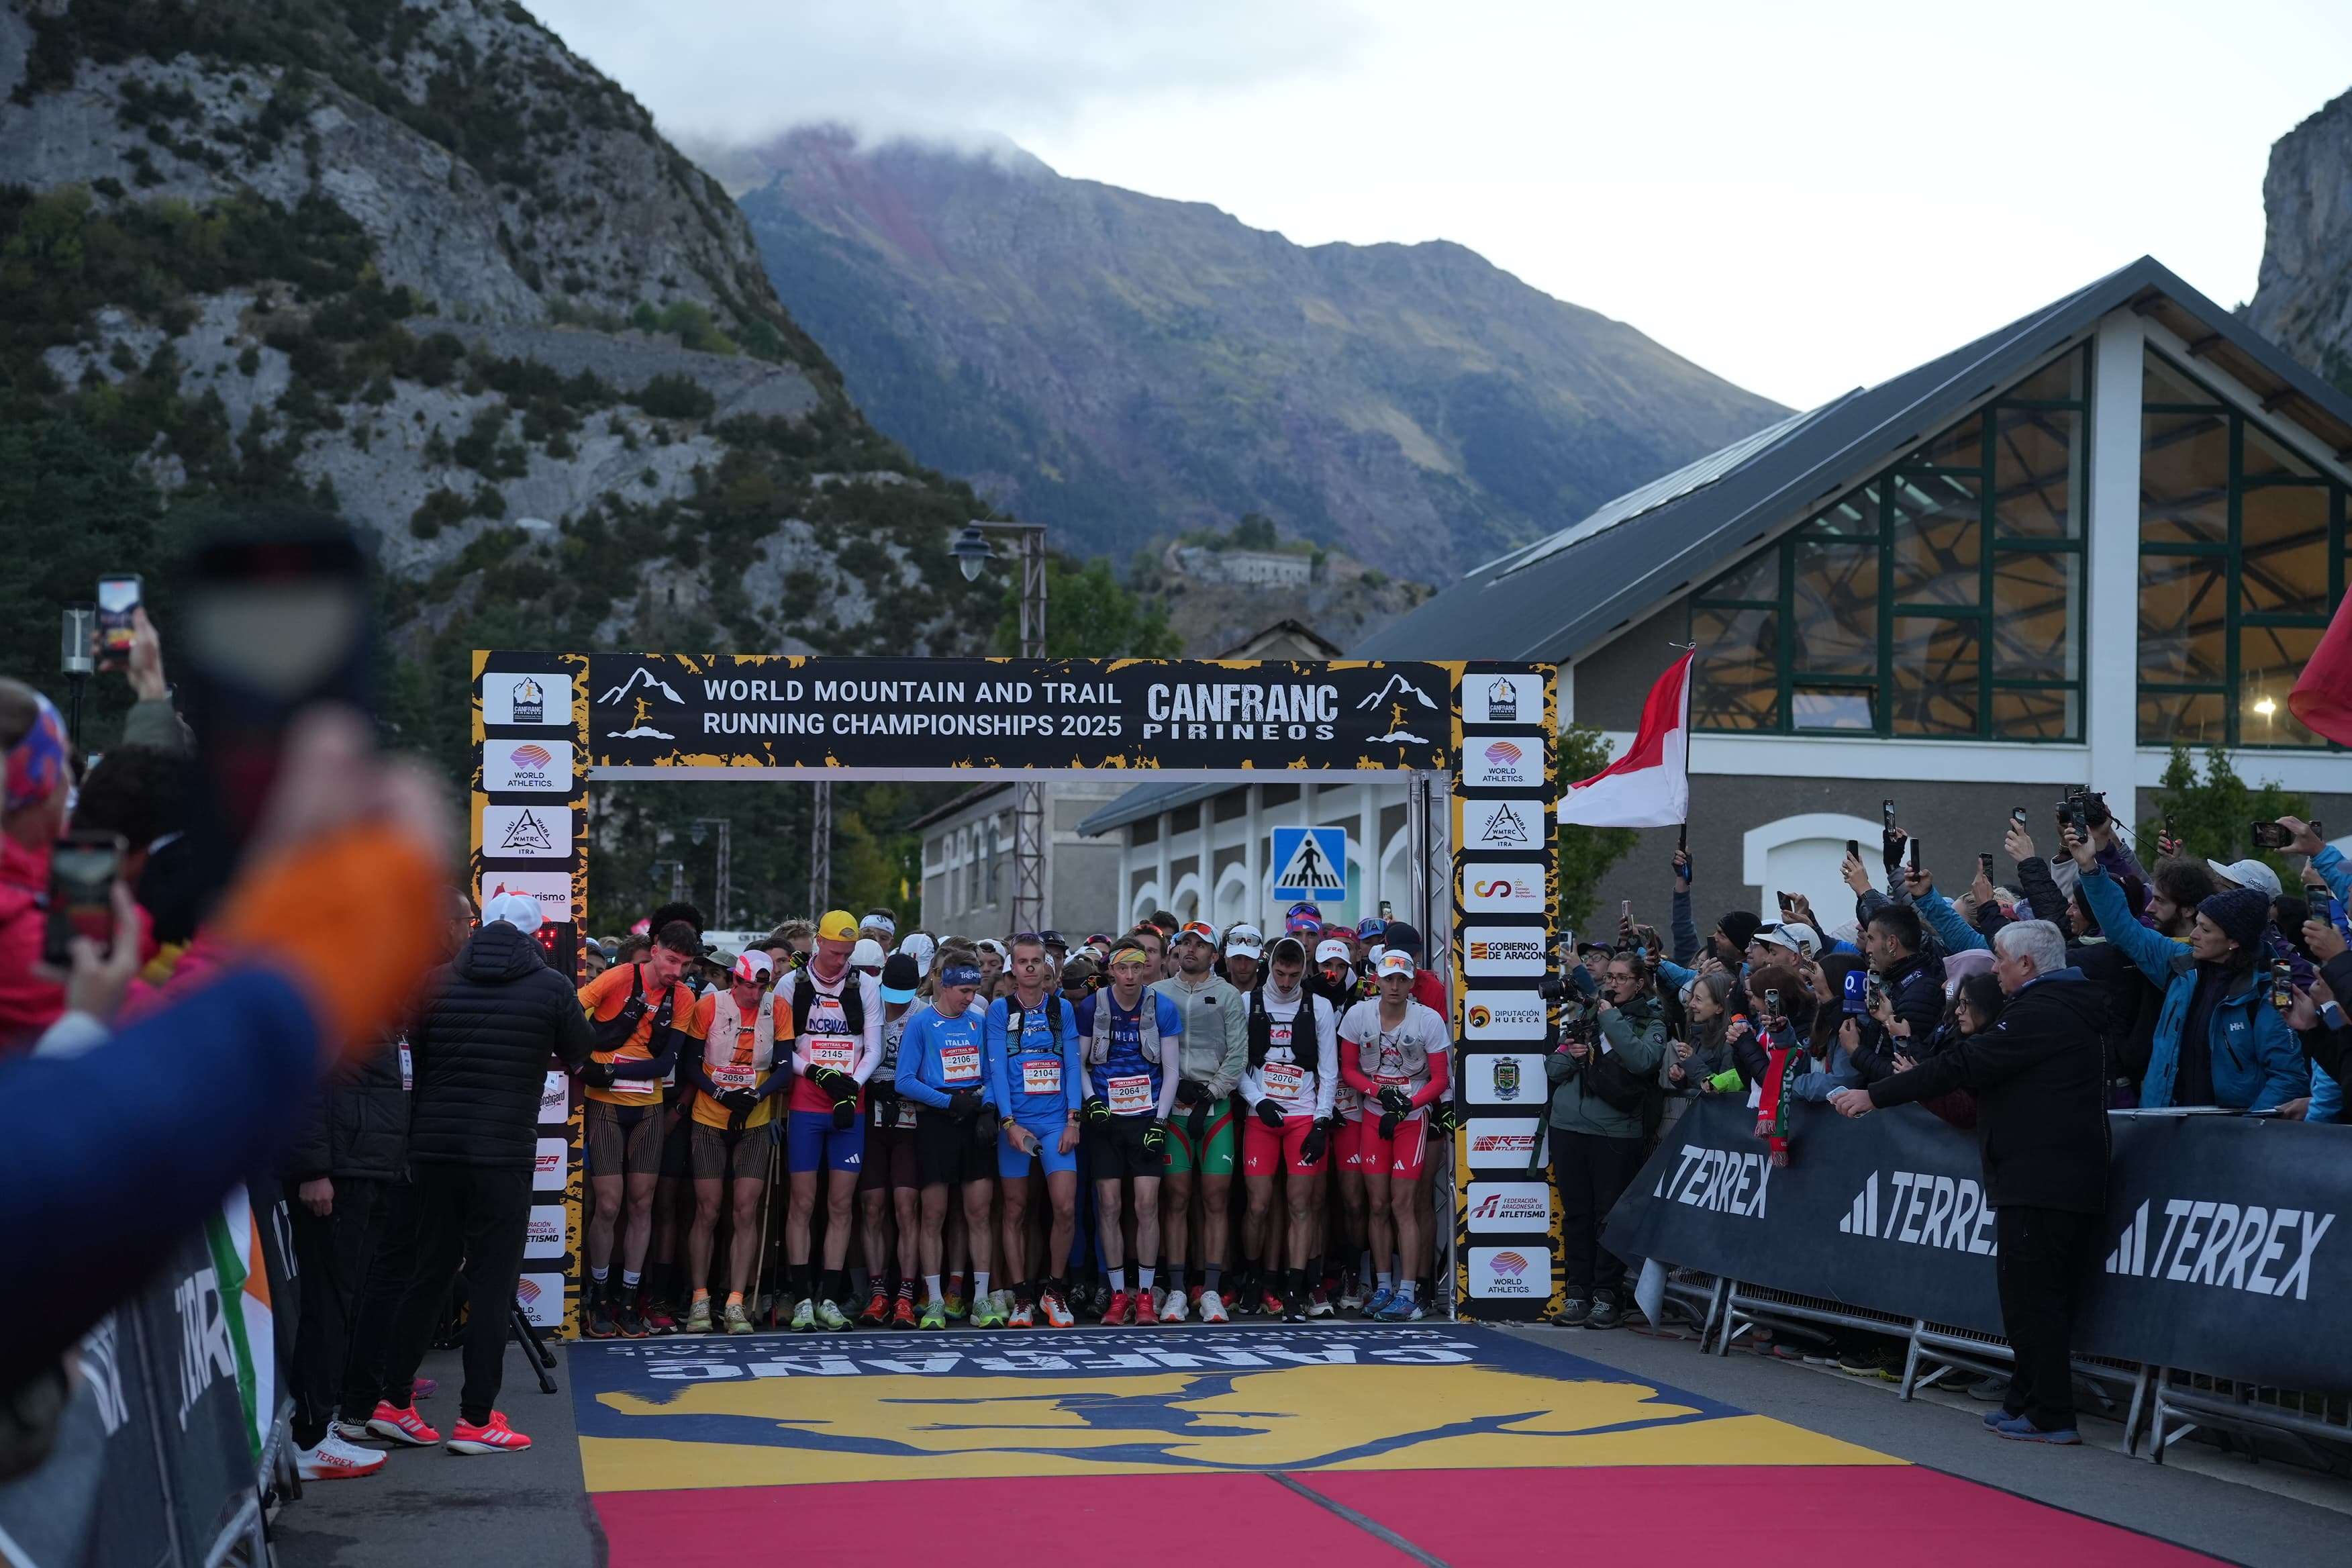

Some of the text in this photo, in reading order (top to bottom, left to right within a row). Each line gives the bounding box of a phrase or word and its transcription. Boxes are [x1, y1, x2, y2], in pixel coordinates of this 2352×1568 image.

[703, 679, 1122, 703] WORLD MOUNTAIN AND TRAIL
[1148, 683, 1338, 722] CANFRANC
[703, 712, 1122, 736] RUNNING CHAMPIONSHIPS 2025
[1143, 724, 1335, 740] PIRINEOS
[1485, 815, 1494, 826] IAU
[1513, 811, 1526, 831] WMRA
[505, 821, 515, 833] IAU
[536, 818, 550, 838] WMRA
[532, 891, 565, 901] rismo
[1488, 942, 1538, 950] GOBIERNO
[1488, 952, 1501, 960] DE
[809, 1018, 848, 1032] NORWA
[2229, 1022, 2245, 1032] HH
[822, 1050, 842, 1058] 2145
[952, 1055, 971, 1064] 2106
[722, 1073, 744, 1082] 2059
[1034, 1069, 1053, 1077] 2104
[1273, 1073, 1293, 1083] 2070
[1119, 1087, 1140, 1095] 2064
[1336, 1089, 1347, 1097] 67
[540, 1090, 565, 1106] otchgard
[1666, 1144, 1773, 1219] TERREX
[1883, 1171, 1998, 1256] TERRE
[526, 1234, 559, 1242] ETISMO
[2149, 1198, 2335, 1300] TERREX
[750, 1333, 1193, 1346] CHAMPIONSHIPS
[937, 1337, 1240, 1347] MOUNTAIN
[606, 1343, 732, 1352] 2025
[606, 1347, 778, 1357] TRAIL
[647, 1349, 1474, 1380] CANFRANC
[315, 1449, 356, 1469] TERREX
